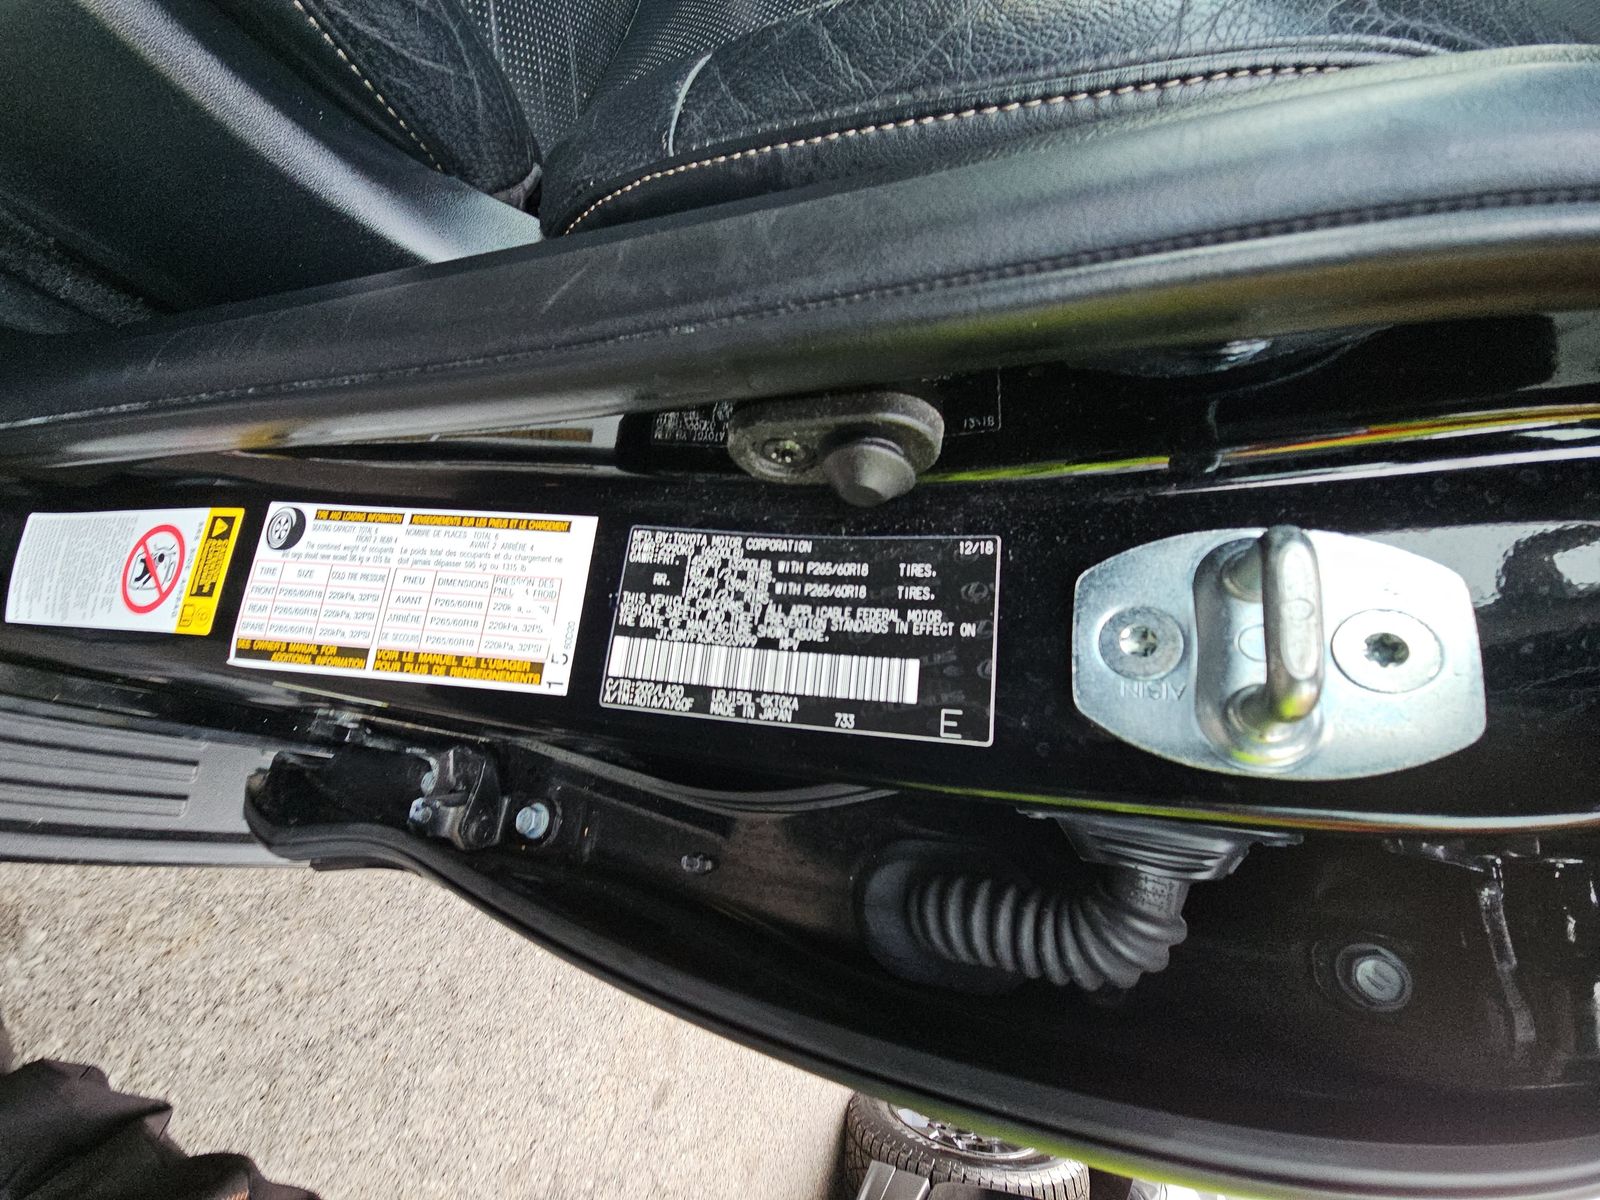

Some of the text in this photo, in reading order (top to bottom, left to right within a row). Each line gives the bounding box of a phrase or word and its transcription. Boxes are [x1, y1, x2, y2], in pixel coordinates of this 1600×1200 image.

[711, 535, 742, 549] MOTOR
[745, 537, 813, 553] CORPORATION
[959, 541, 994, 555] 12/18
[778, 560, 803, 574] WITH
[806, 561, 869, 577] P265/60R18
[899, 563, 937, 577] TIRES.
[403, 575, 426, 586] PNEU
[437, 577, 489, 589] DIMENSIONS
[653, 572, 671, 586] RR.
[775, 581, 801, 596] WITH
[803, 583, 867, 599] P265/60R18
[897, 585, 936, 600] TIRES.
[395, 595, 422, 605] AVANT
[623, 591, 646, 605] THIS
[651, 593, 690, 609] VEHICLE
[789, 604, 852, 620] APPLICABLE
[856, 607, 900, 622] FEDERAL
[906, 609, 943, 623] MOTOR
[619, 602, 660, 618] VEHICLE
[664, 605, 702, 620] SAFETY
[705, 610, 725, 622] AND
[830, 618, 888, 634] STANDARDS
[895, 621, 908, 635] IN
[912, 622, 955, 637] EFFECT
[959, 623, 977, 638] ON
[619, 612, 635, 627] THE
[639, 614, 665, 629] DATE
[668, 617, 682, 630] OF
[373, 660, 400, 671] POUR
[404, 662, 428, 674] PLUS
[432, 664, 446, 676] DE
[376, 649, 530, 672] VOIR LE MANUEL DE L'USAGER
[1120, 680, 1187, 702] AISIN
[710, 701, 736, 717] MADE
[742, 701, 755, 719] IN
[759, 707, 793, 723] JAPAN
[834, 711, 855, 729] 733
[940, 708, 963, 739] E
